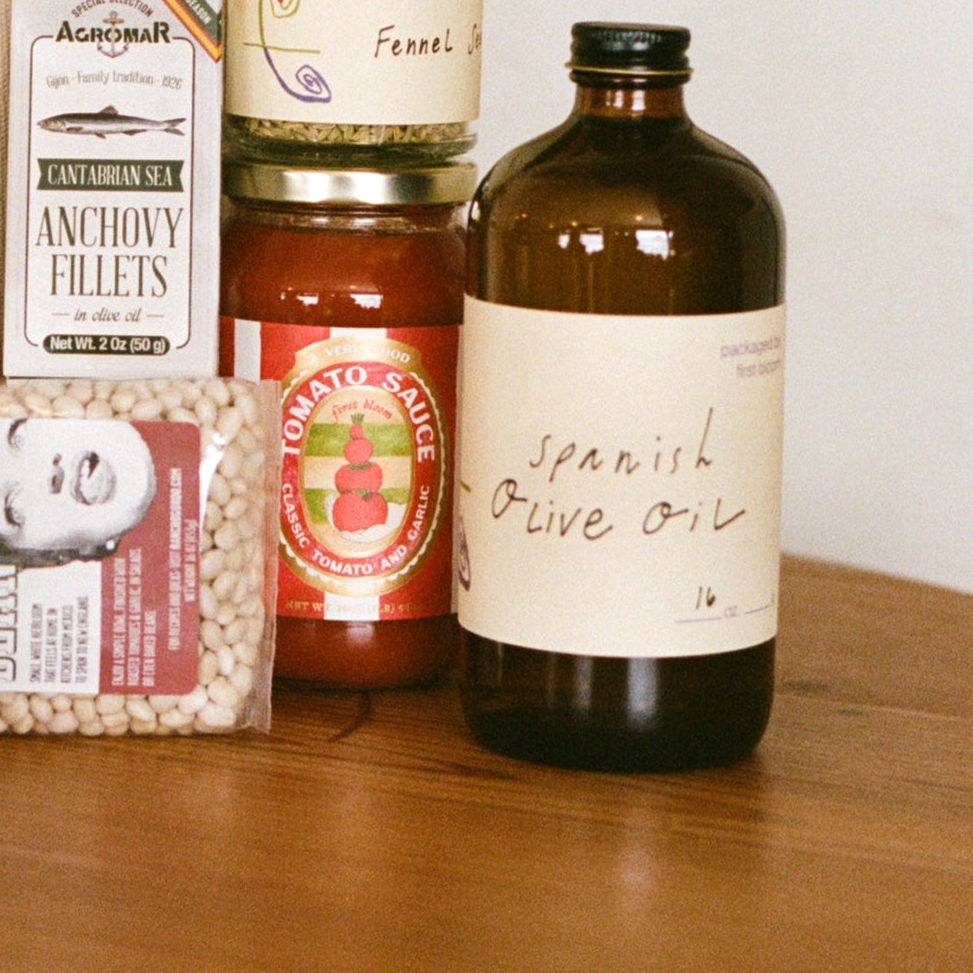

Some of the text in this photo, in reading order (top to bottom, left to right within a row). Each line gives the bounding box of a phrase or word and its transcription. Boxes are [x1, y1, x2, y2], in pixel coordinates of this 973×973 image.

[77, 70, 110, 86] Family
[112, 70, 154, 84] tradition
[47, 163, 173, 187] CANTABRIAN SEA
[35, 206, 184, 249] ANCHOVY
[50, 254, 168, 298] FILLETS
[74, 307, 142, 323] in olive oil
[49, 336, 166, 353] Net Wt. 2 Oz (50 g)
[282, 365, 436, 463] TOMATO SAUCE
[282, 483, 431, 576] CLASSIC TOMATO AND GARLIC
[695, 586, 716, 610] 16
